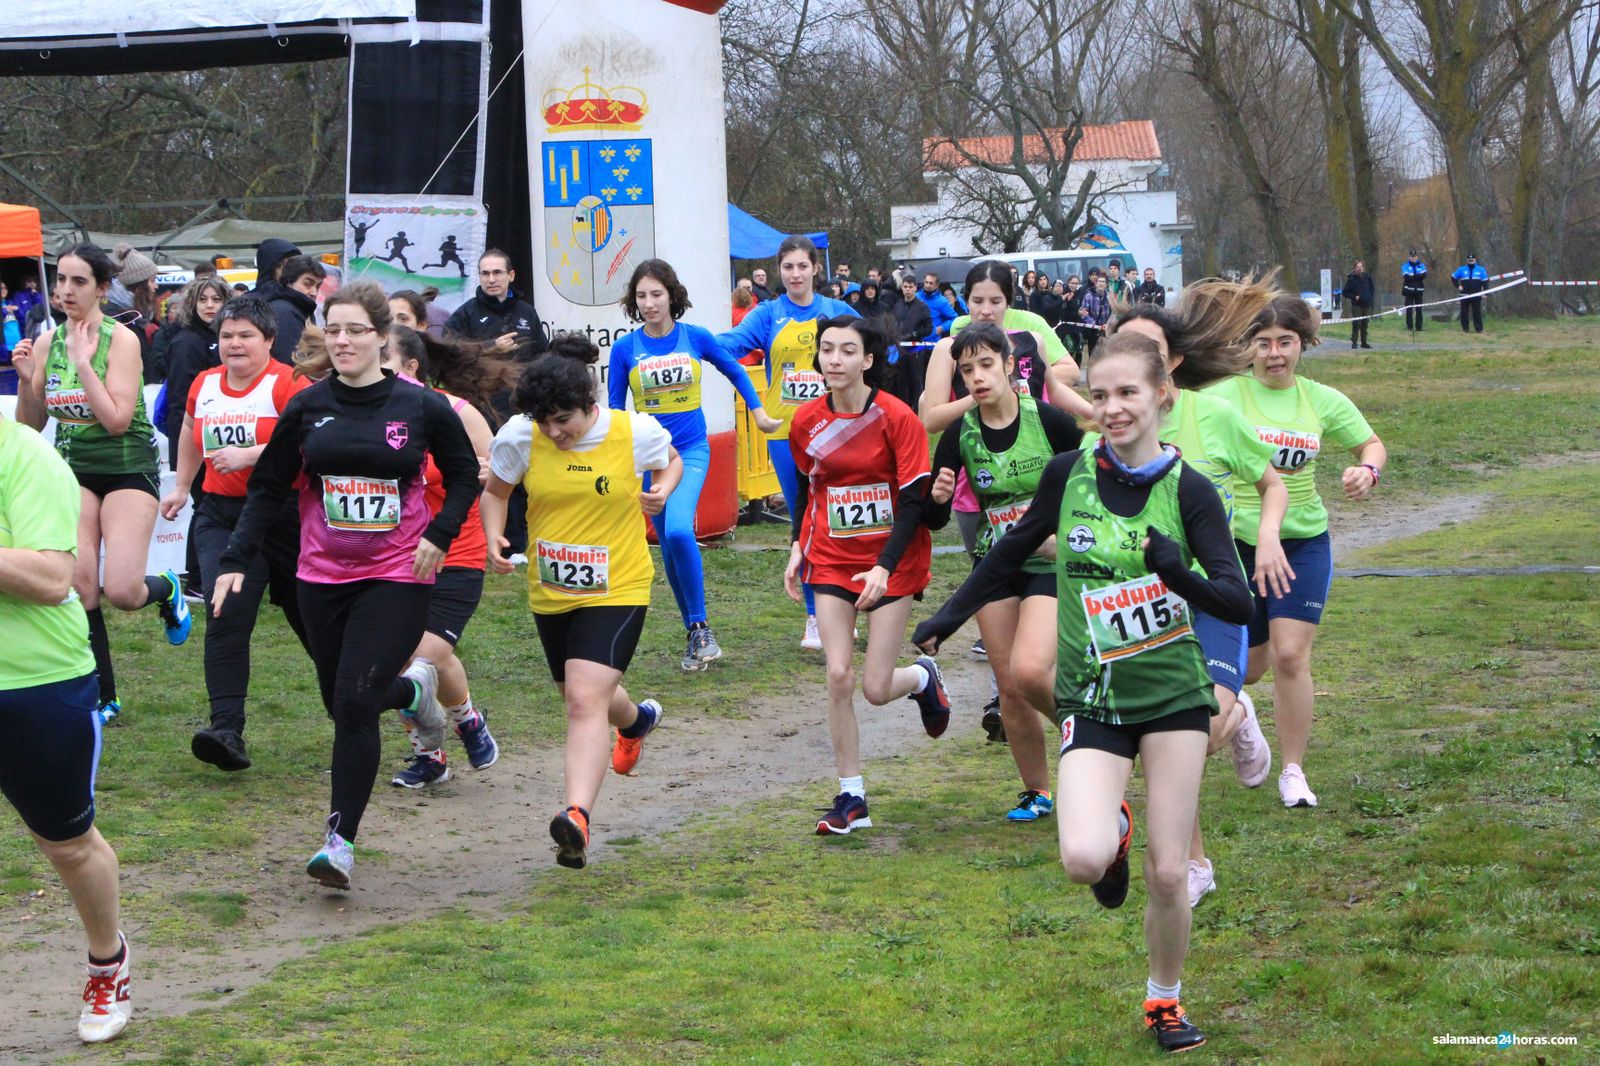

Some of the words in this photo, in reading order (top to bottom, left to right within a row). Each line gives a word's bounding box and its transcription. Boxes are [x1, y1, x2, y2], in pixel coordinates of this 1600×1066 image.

[640, 357, 690, 371] bedunia
[651, 367, 683, 385] 187
[788, 382, 819, 398] 122
[204, 413, 255, 426] bedunia
[213, 425, 246, 446] 120
[324, 479, 397, 495] bedunia
[829, 487, 889, 505] bedunia
[339, 495, 386, 519] 117
[836, 502, 878, 527] 121
[156, 532, 184, 543] TOYOTA
[538, 543, 607, 563] bedunia
[550, 561, 594, 587] 123
[1085, 576, 1169, 617] beduni
[1110, 597, 1172, 642] 115
